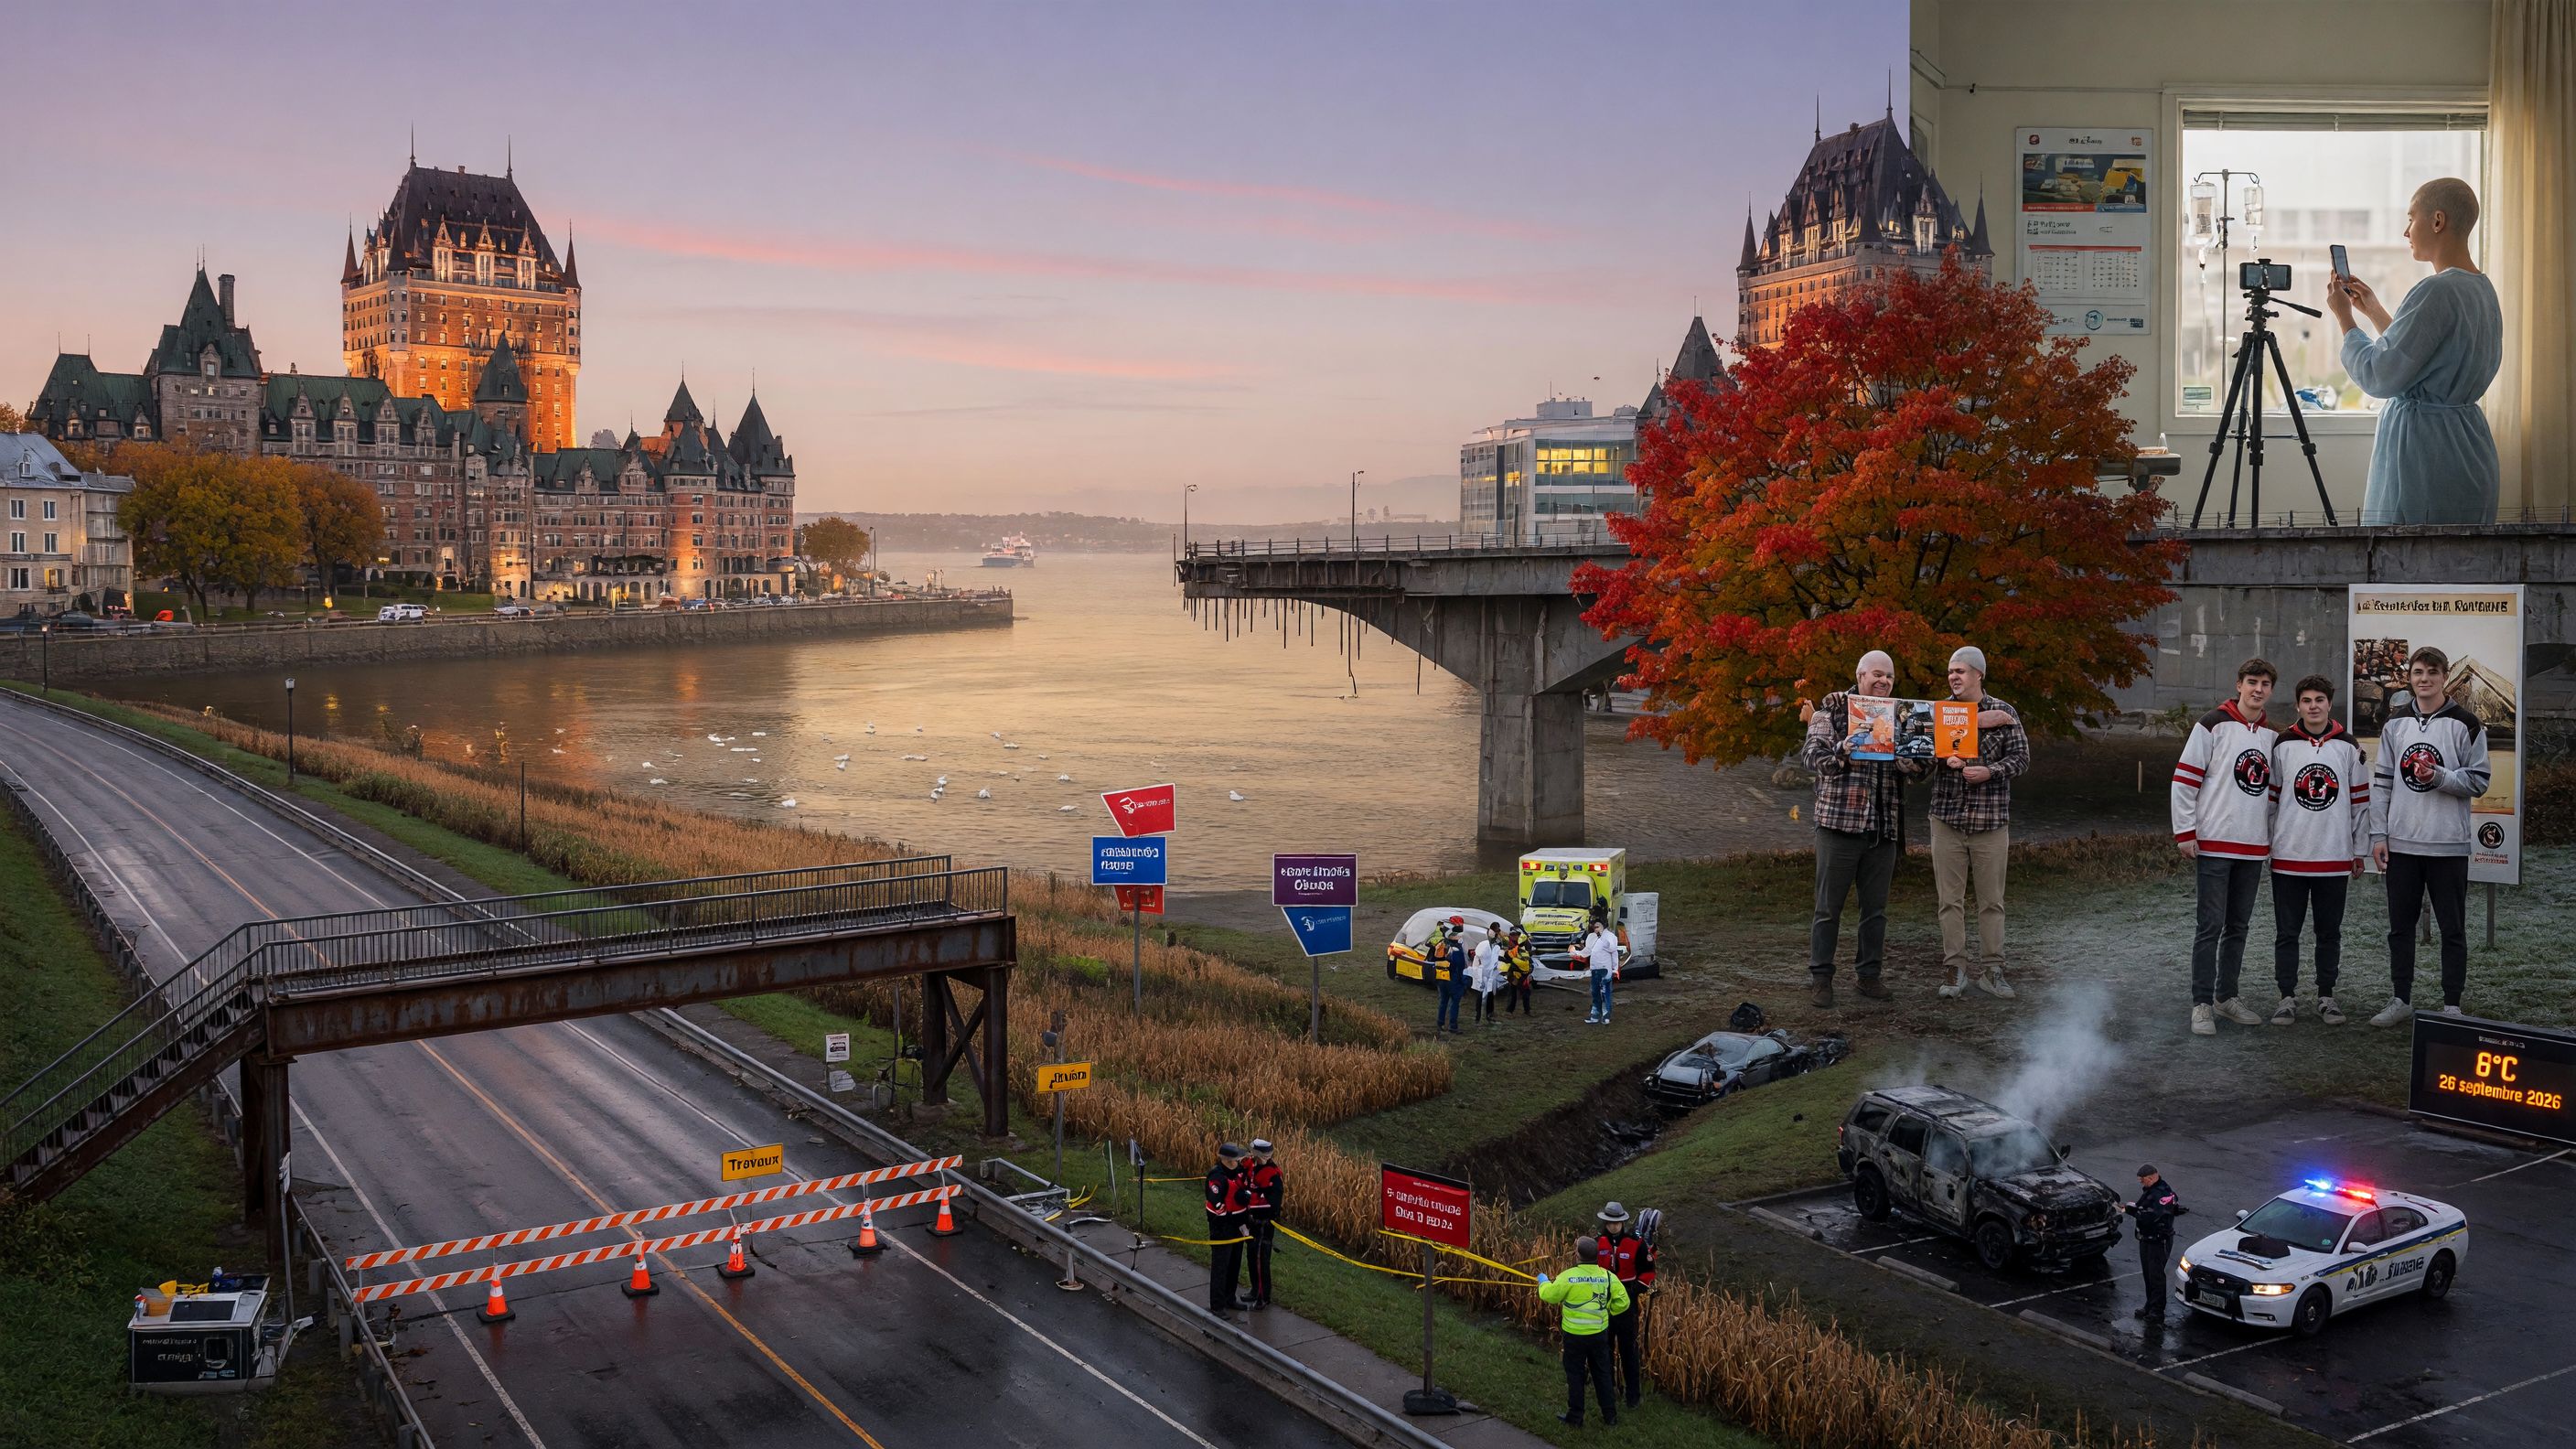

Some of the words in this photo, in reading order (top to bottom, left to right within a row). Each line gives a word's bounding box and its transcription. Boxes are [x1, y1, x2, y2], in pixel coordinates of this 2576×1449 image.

[2439, 1074, 2456, 1090] 26
[2459, 1079, 2523, 1102] septembre
[2526, 1089, 2561, 1110] 2026
